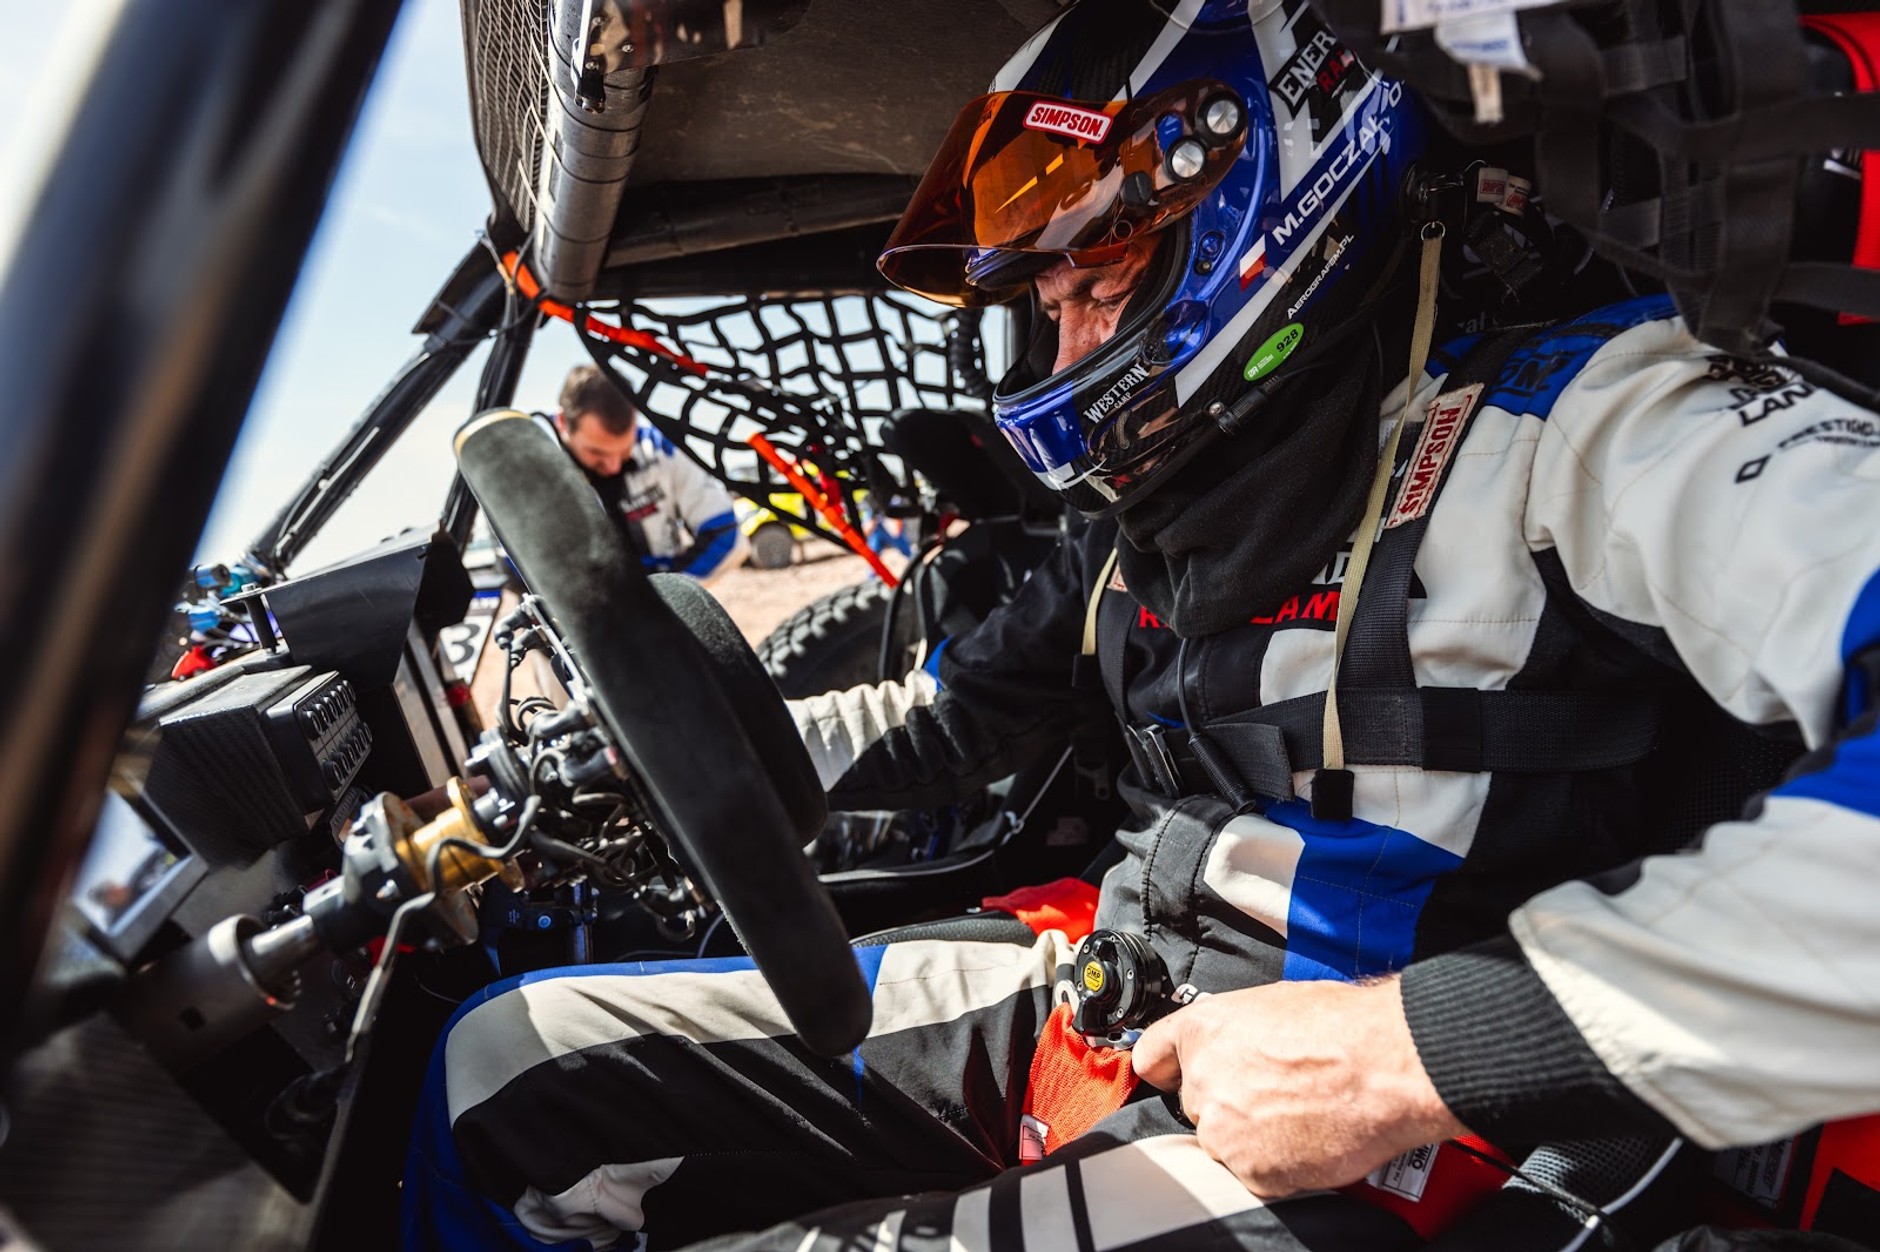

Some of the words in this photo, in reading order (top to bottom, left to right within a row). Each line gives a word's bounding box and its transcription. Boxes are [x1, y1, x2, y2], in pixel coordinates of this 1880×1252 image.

[1276, 328, 1299, 353] 928
[1083, 363, 1150, 424] WESTERN
[1114, 391, 1132, 409] CAMP
[1399, 406, 1462, 515] SIMPSON
[1086, 967, 1101, 980] OMP
